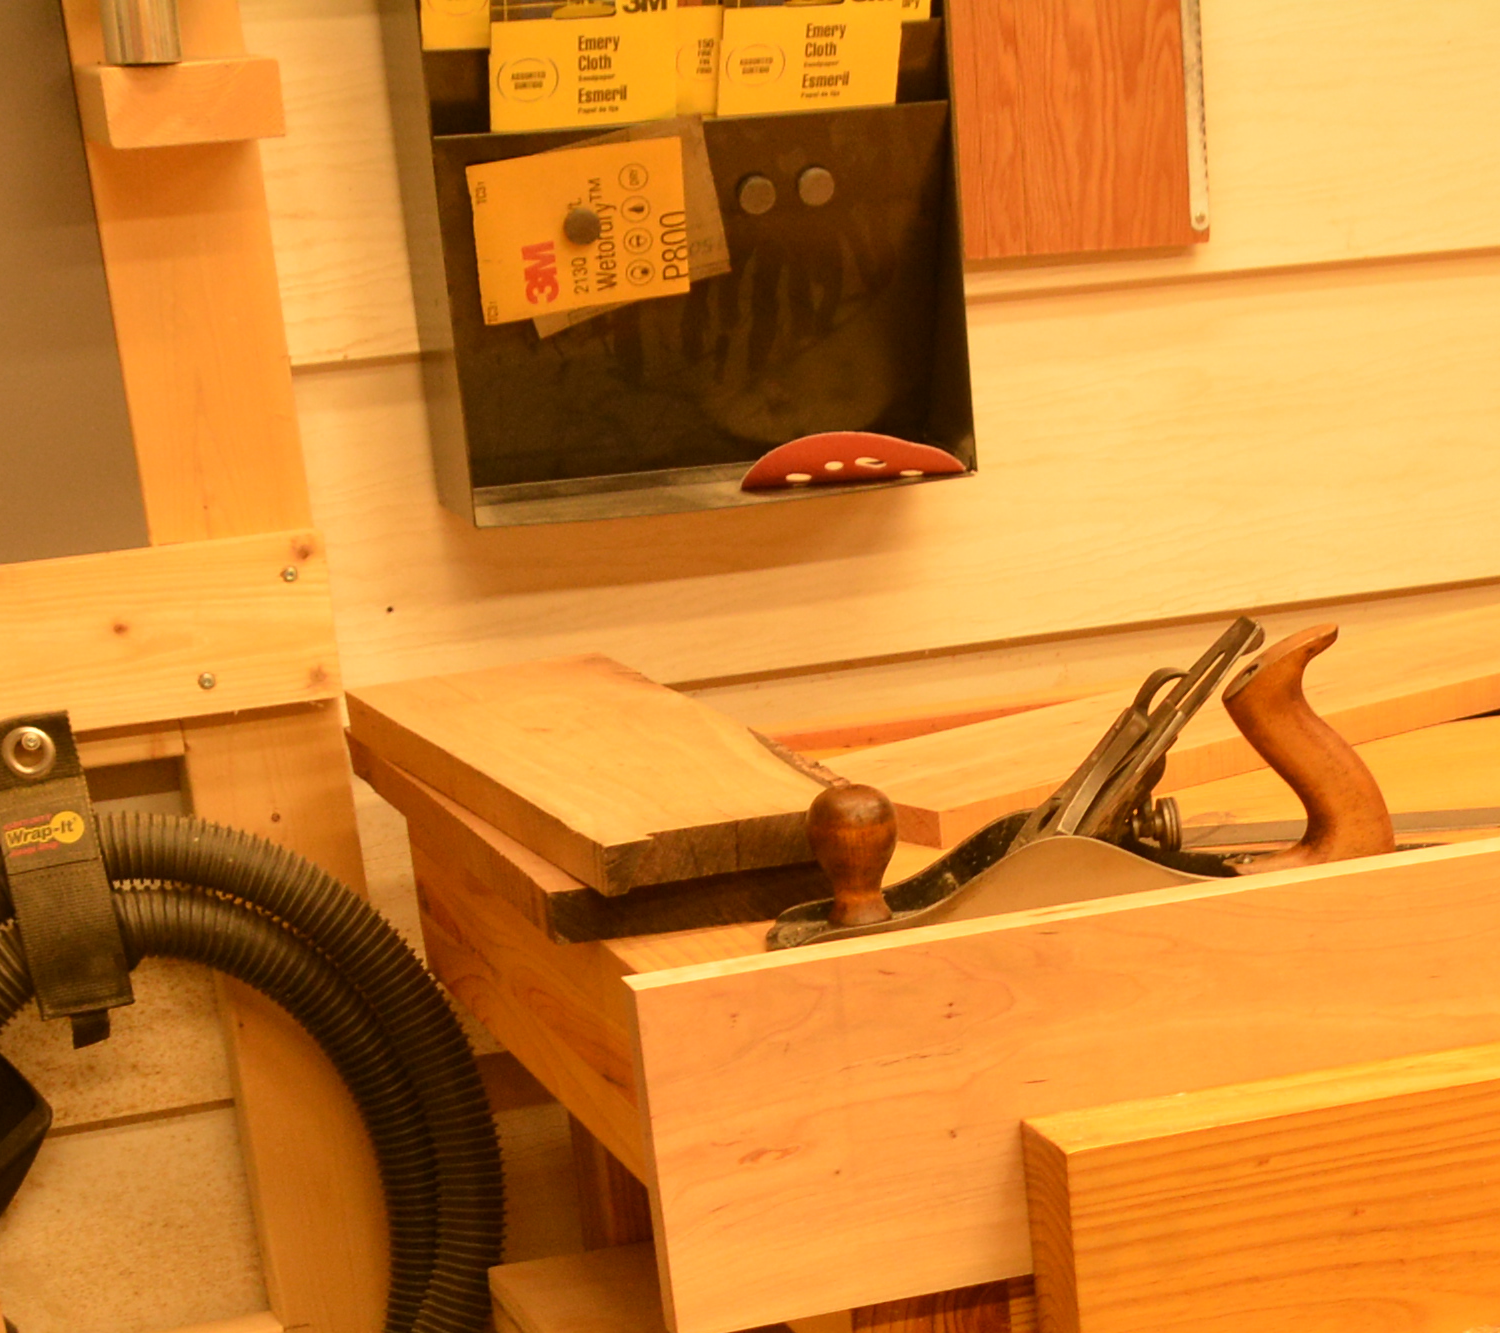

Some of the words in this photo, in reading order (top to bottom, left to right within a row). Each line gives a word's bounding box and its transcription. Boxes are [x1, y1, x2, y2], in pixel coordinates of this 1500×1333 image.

[805, 23, 847, 40] Emery
[577, 35, 620, 52] Emery
[804, 42, 837, 59] Cloth
[577, 55, 612, 72] Cloth
[801, 71, 850, 89] Esmeril
[577, 85, 628, 104] Esmeril
[659, 210, 689, 282] P800
[521, 241, 560, 304] 3M
